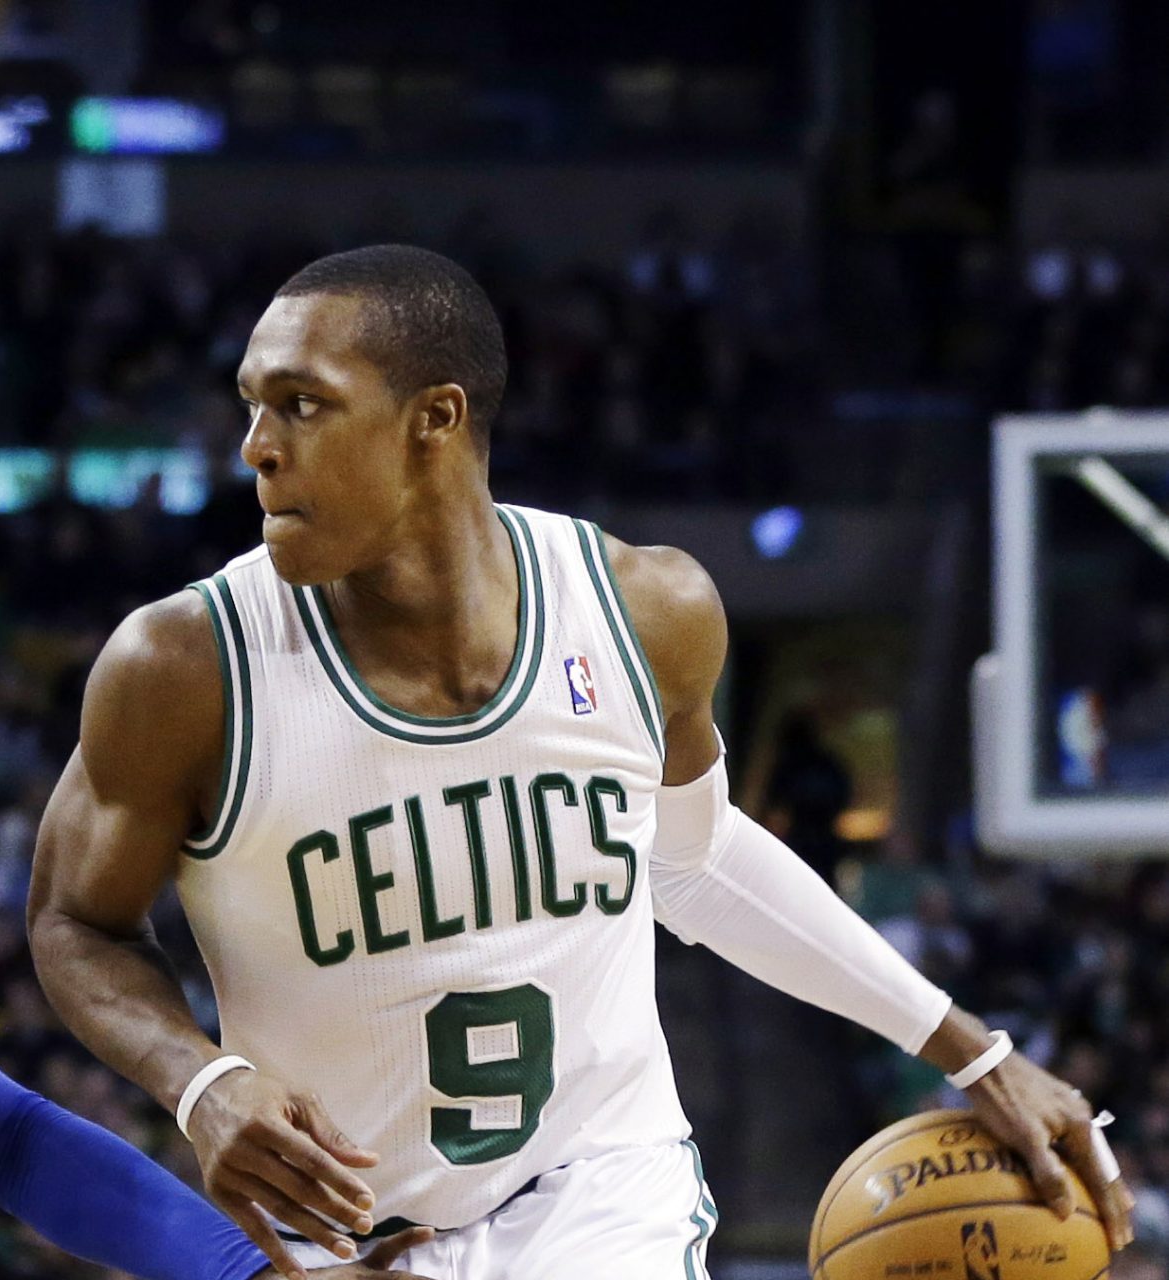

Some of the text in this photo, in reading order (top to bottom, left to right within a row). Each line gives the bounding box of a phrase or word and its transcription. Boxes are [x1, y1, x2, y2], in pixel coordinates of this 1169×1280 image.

[286, 772, 637, 967] CELTICS
[425, 979, 556, 1169] 9
[865, 1149, 1020, 1216] SPALDI
